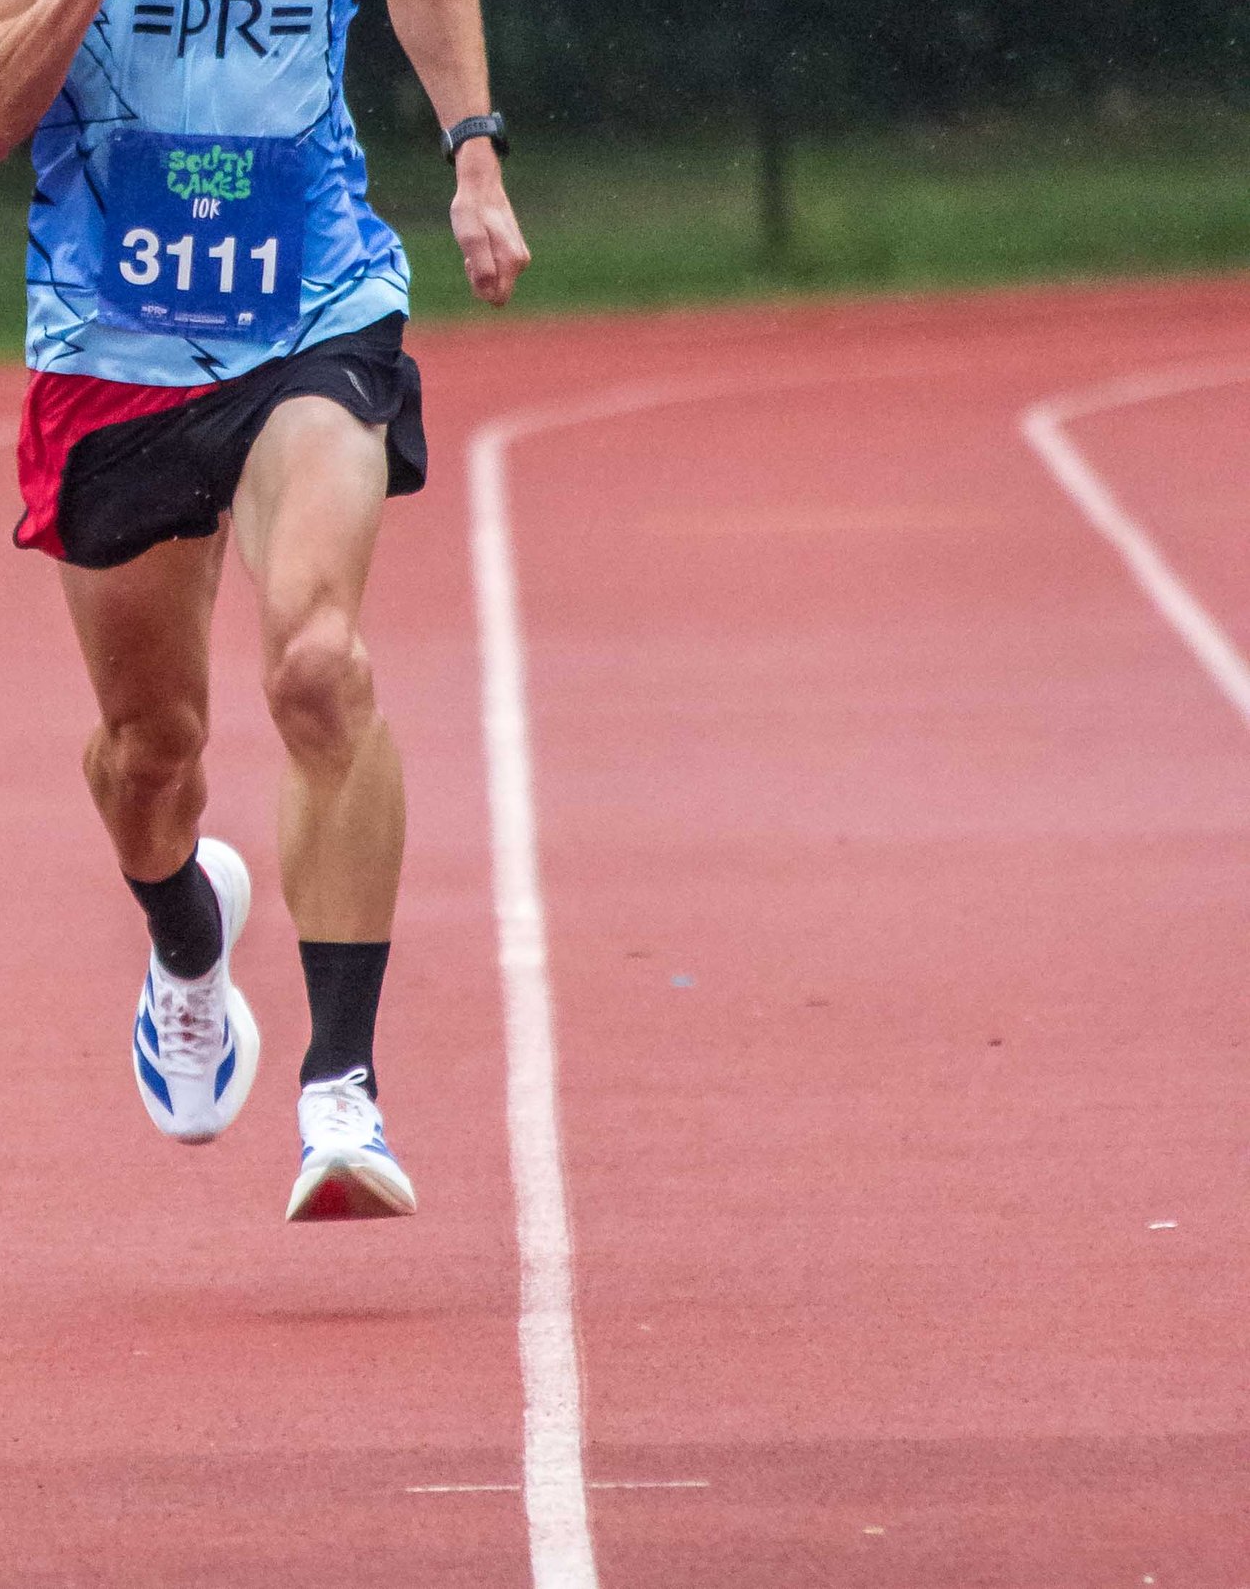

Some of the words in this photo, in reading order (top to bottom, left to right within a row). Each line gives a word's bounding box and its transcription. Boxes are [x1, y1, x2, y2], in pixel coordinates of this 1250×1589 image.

[168, 145, 254, 175] SOUTH
[167, 171, 252, 201] LAKES
[192, 197, 222, 219] 10K
[119, 228, 278, 294] 3111
